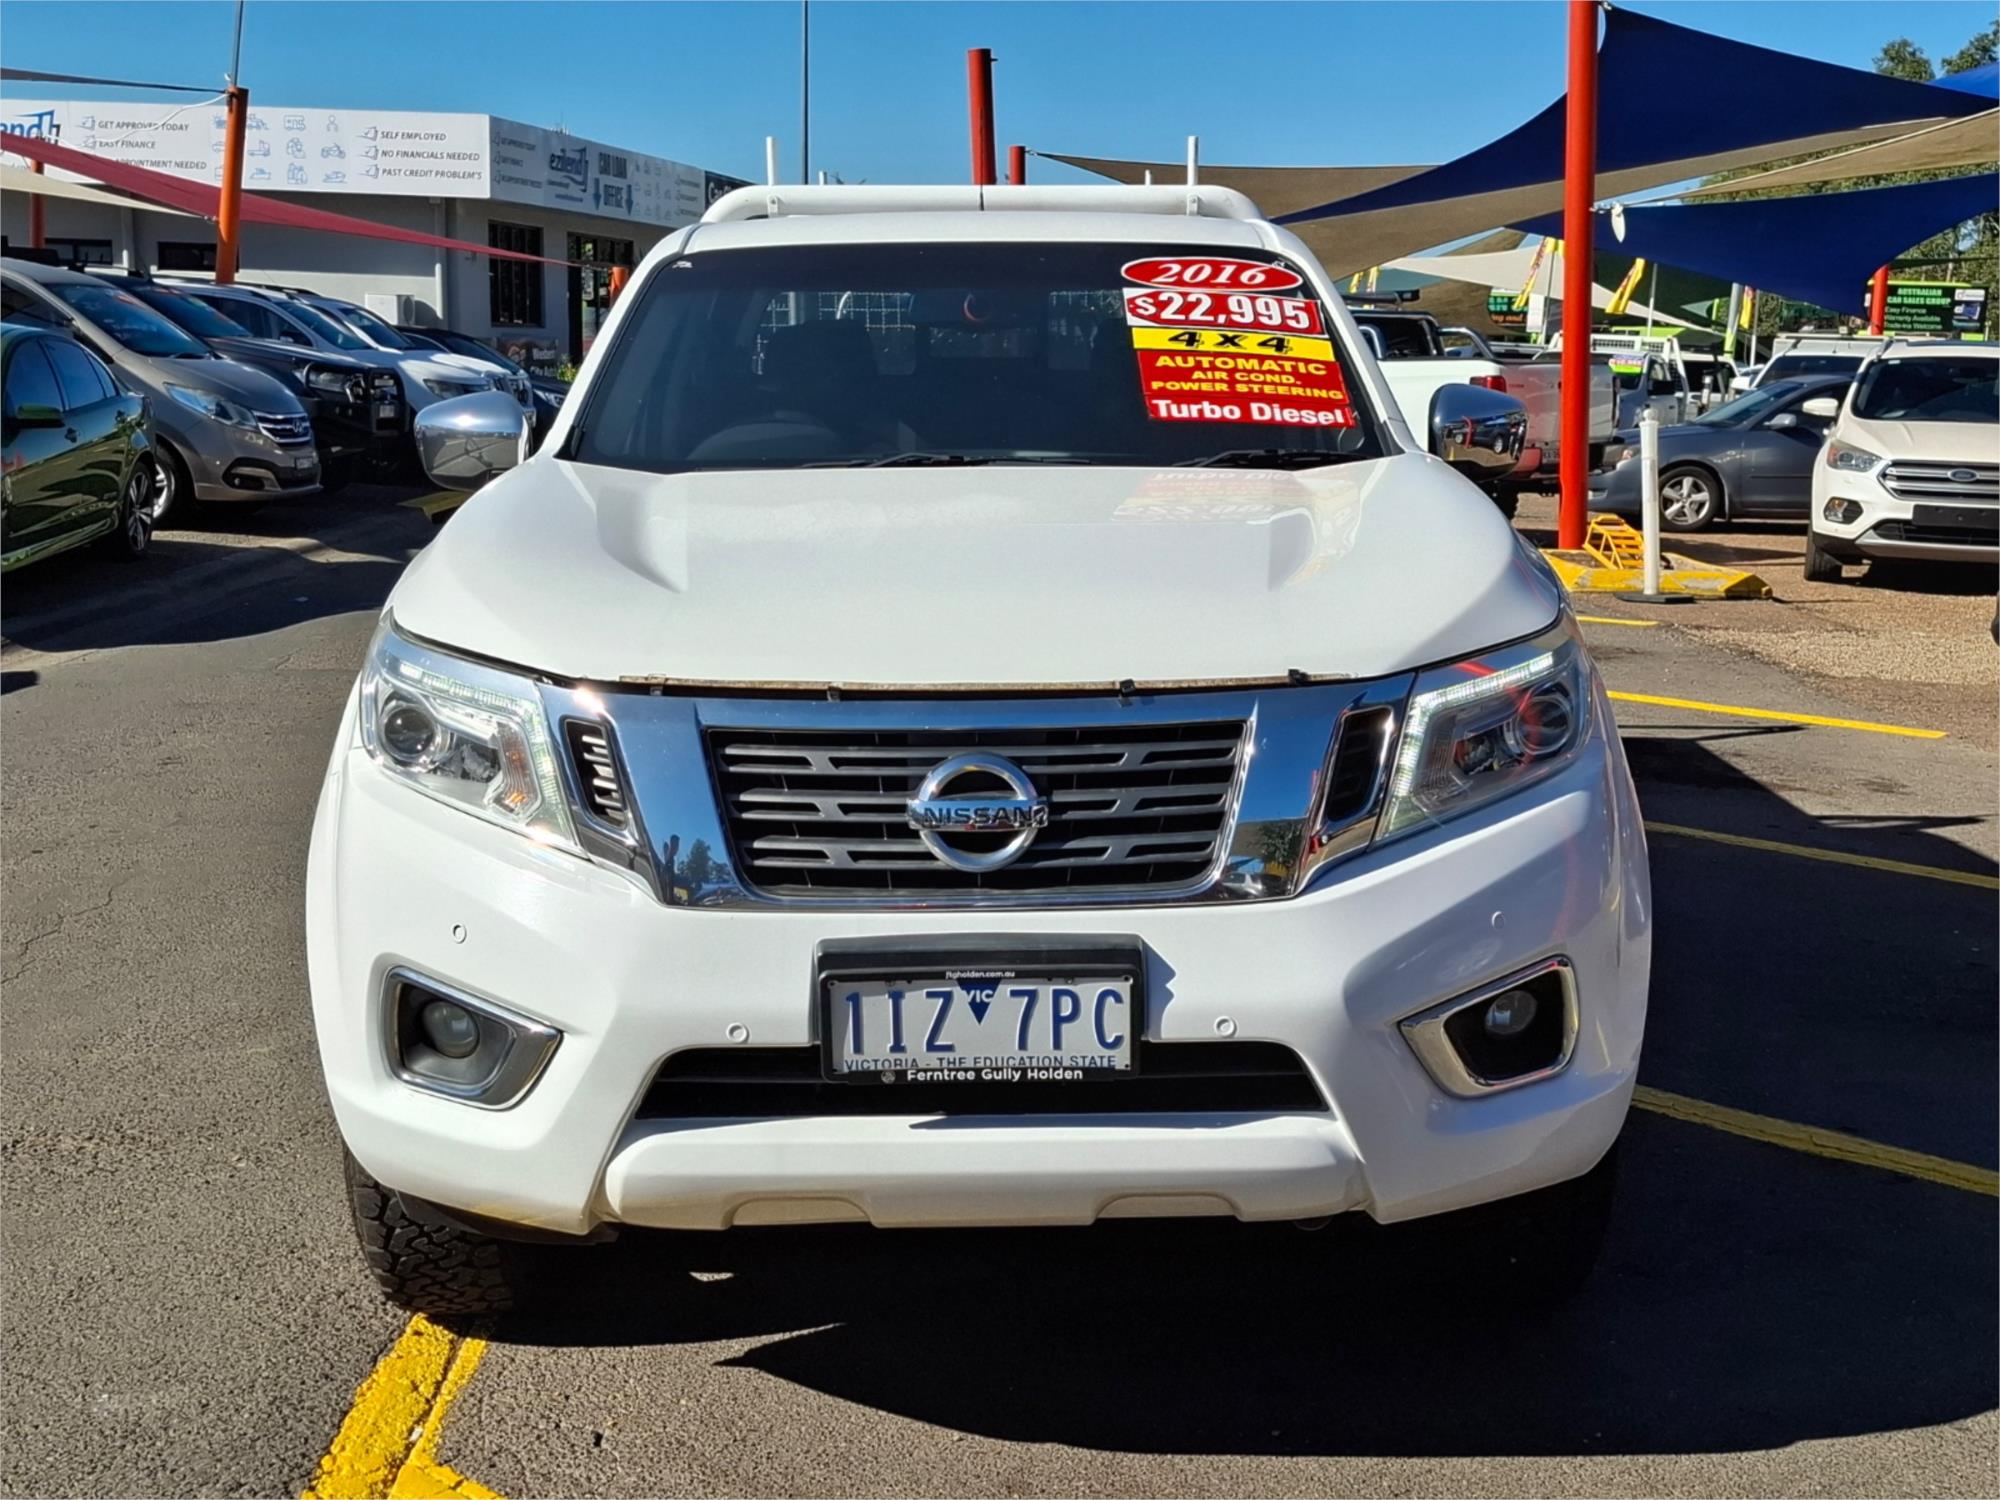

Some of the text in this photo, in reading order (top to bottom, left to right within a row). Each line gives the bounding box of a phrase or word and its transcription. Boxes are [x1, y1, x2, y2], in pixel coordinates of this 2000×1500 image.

[98, 120, 114, 129] GET
[161, 123, 190, 131] TODAY
[380, 131, 447, 141] SELF EMPLOYED
[120, 140, 156, 149] FINANCE
[381, 150, 481, 161] NO FINANCIALS NEEDED
[174, 160, 207, 170] NEEDED
[382, 168, 483, 180] PAST CREDIT PROBLEM'S
[1150, 263, 1267, 285] 2016
[1897, 288, 1943, 297] AUSTRALIAN
[1887, 296, 1952, 306] CAR SALES GROUP
[1155, 355, 1328, 375] AUTOMATIC
[1191, 370, 1302, 385] AIR COND.
[1151, 381, 1344, 400] POWER STEERING
[1152, 399, 1345, 425] Turbo Diesel
[923, 805, 1032, 824] NISSAN
[966, 988, 994, 1003] VIC
[846, 987, 1125, 1055] 1IZ 7PC
[844, 1057, 920, 1071] VICTORIA
[936, 1055, 966, 1068] THE
[973, 1055, 1064, 1068] EDUCATION
[1070, 1055, 1117, 1068] STATE
[906, 1067, 1083, 1082] Ferntree Gully Holden
